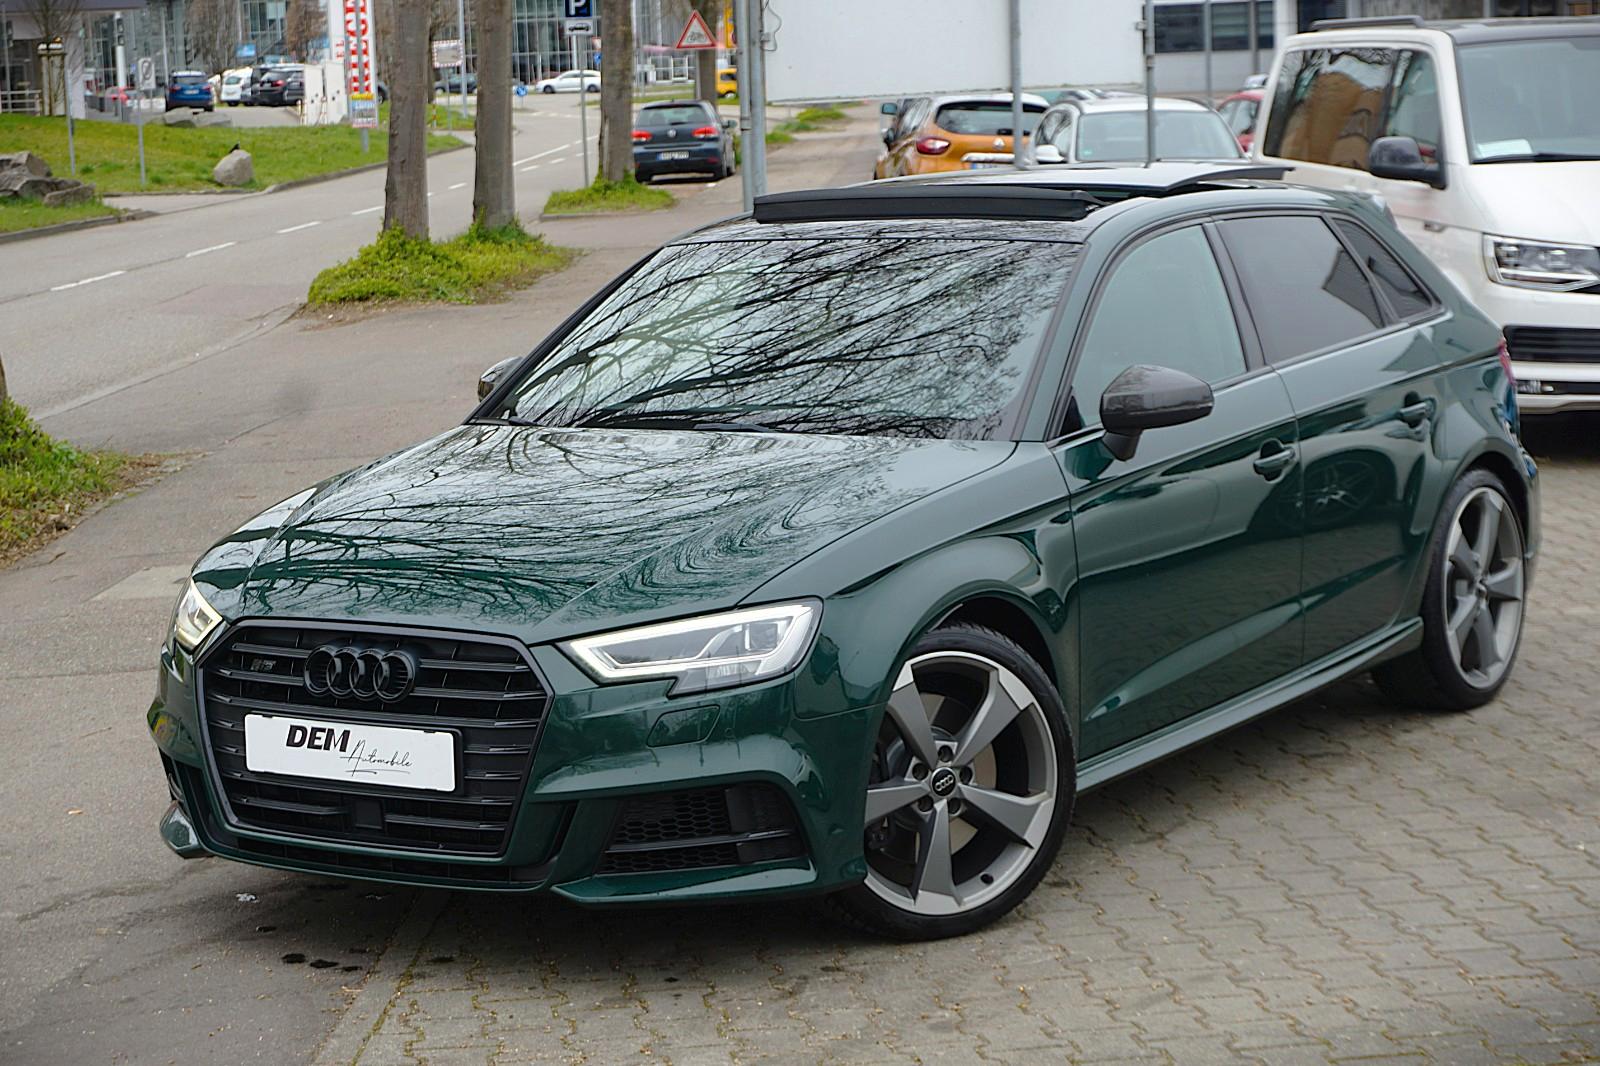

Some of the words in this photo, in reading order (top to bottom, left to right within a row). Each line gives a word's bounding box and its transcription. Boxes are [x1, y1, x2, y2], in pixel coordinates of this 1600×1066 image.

[569, 0, 586, 16] P
[286, 724, 350, 752] DEM
[340, 740, 413, 776] Automobile
